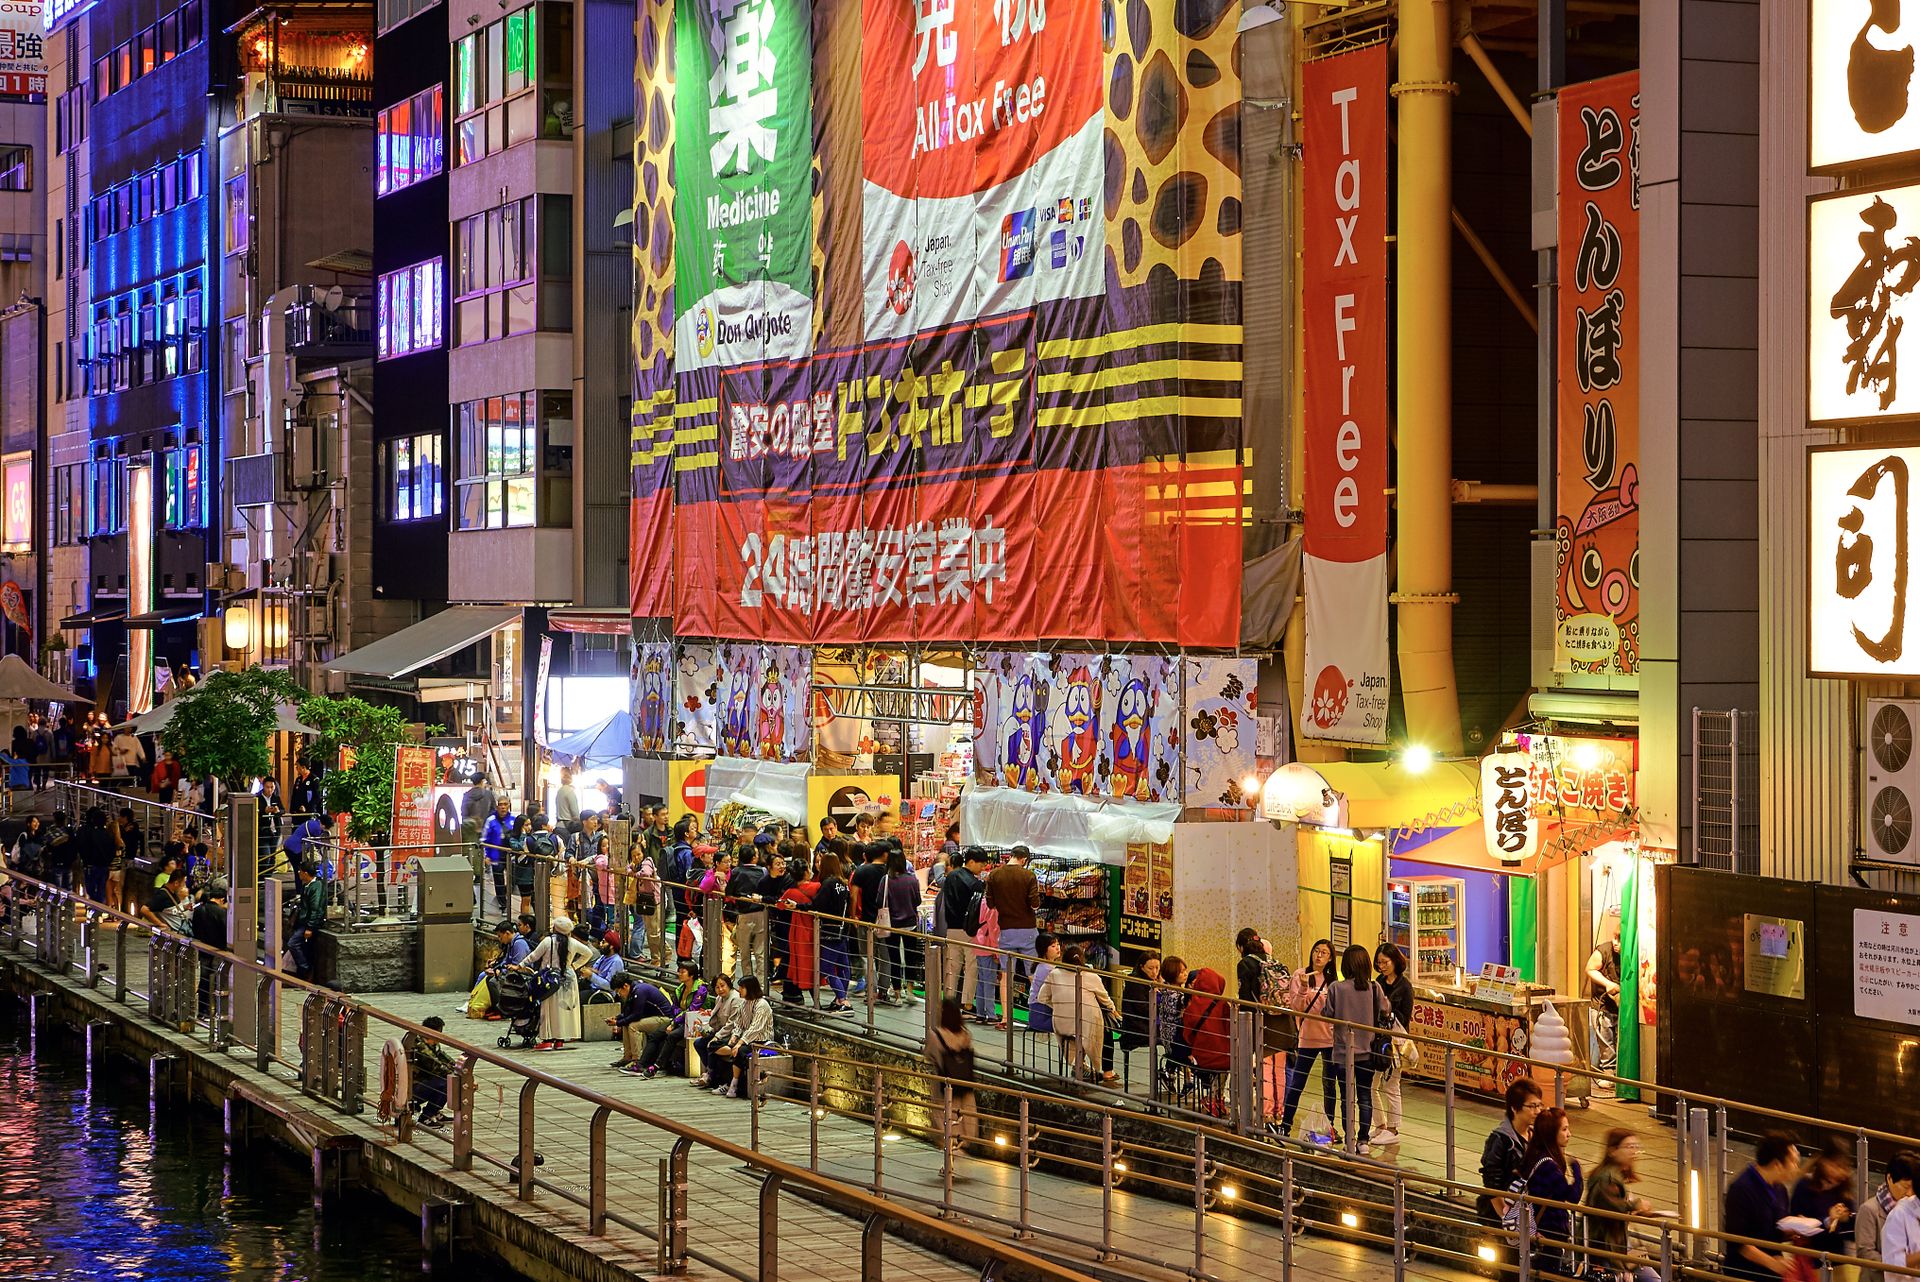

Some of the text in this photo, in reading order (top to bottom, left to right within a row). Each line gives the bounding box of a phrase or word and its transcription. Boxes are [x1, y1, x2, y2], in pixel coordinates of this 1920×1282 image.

[912, 76, 1046, 160] All Tax Free
[1332, 87, 1361, 267] Tax
[707, 188, 780, 231] Medicine
[1040, 207, 1056, 222] VISA
[1002, 226, 1033, 250] UnionPay
[922, 259, 954, 279] Tax-free
[933, 279, 953, 299] Shop
[1575, 106, 1624, 493] とんぼり
[717, 312, 792, 347] Don Quijote
[729, 391, 835, 462] 驚安の殿堂
[1334, 294, 1361, 528] Free
[740, 514, 1006, 616] 24時間驚安営業中
[1356, 693, 1387, 710] Tax-free
[1363, 712, 1385, 731] Shop
[1537, 767, 1629, 812] たこ焼き
[399, 818, 431, 827] supplies
[400, 808, 431, 818] Medical
[1495, 766, 1527, 852] とんぼり
[1410, 1004, 1445, 1029] こ焼き
